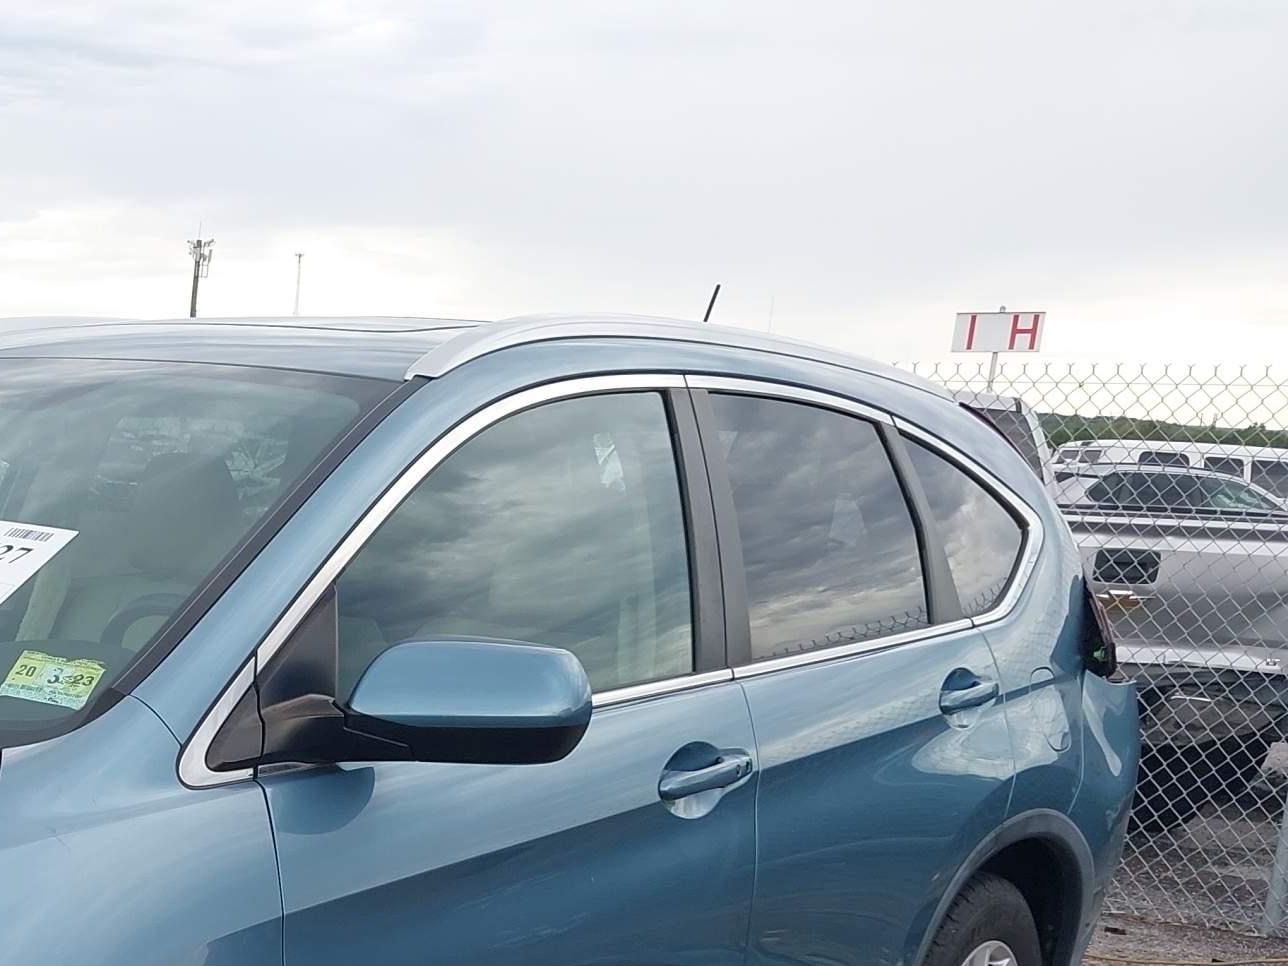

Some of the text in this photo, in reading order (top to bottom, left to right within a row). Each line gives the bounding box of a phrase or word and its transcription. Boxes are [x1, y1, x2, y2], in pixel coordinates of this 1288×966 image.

[965, 314, 1040, 350] I H
[14, 664, 37, 677] 20
